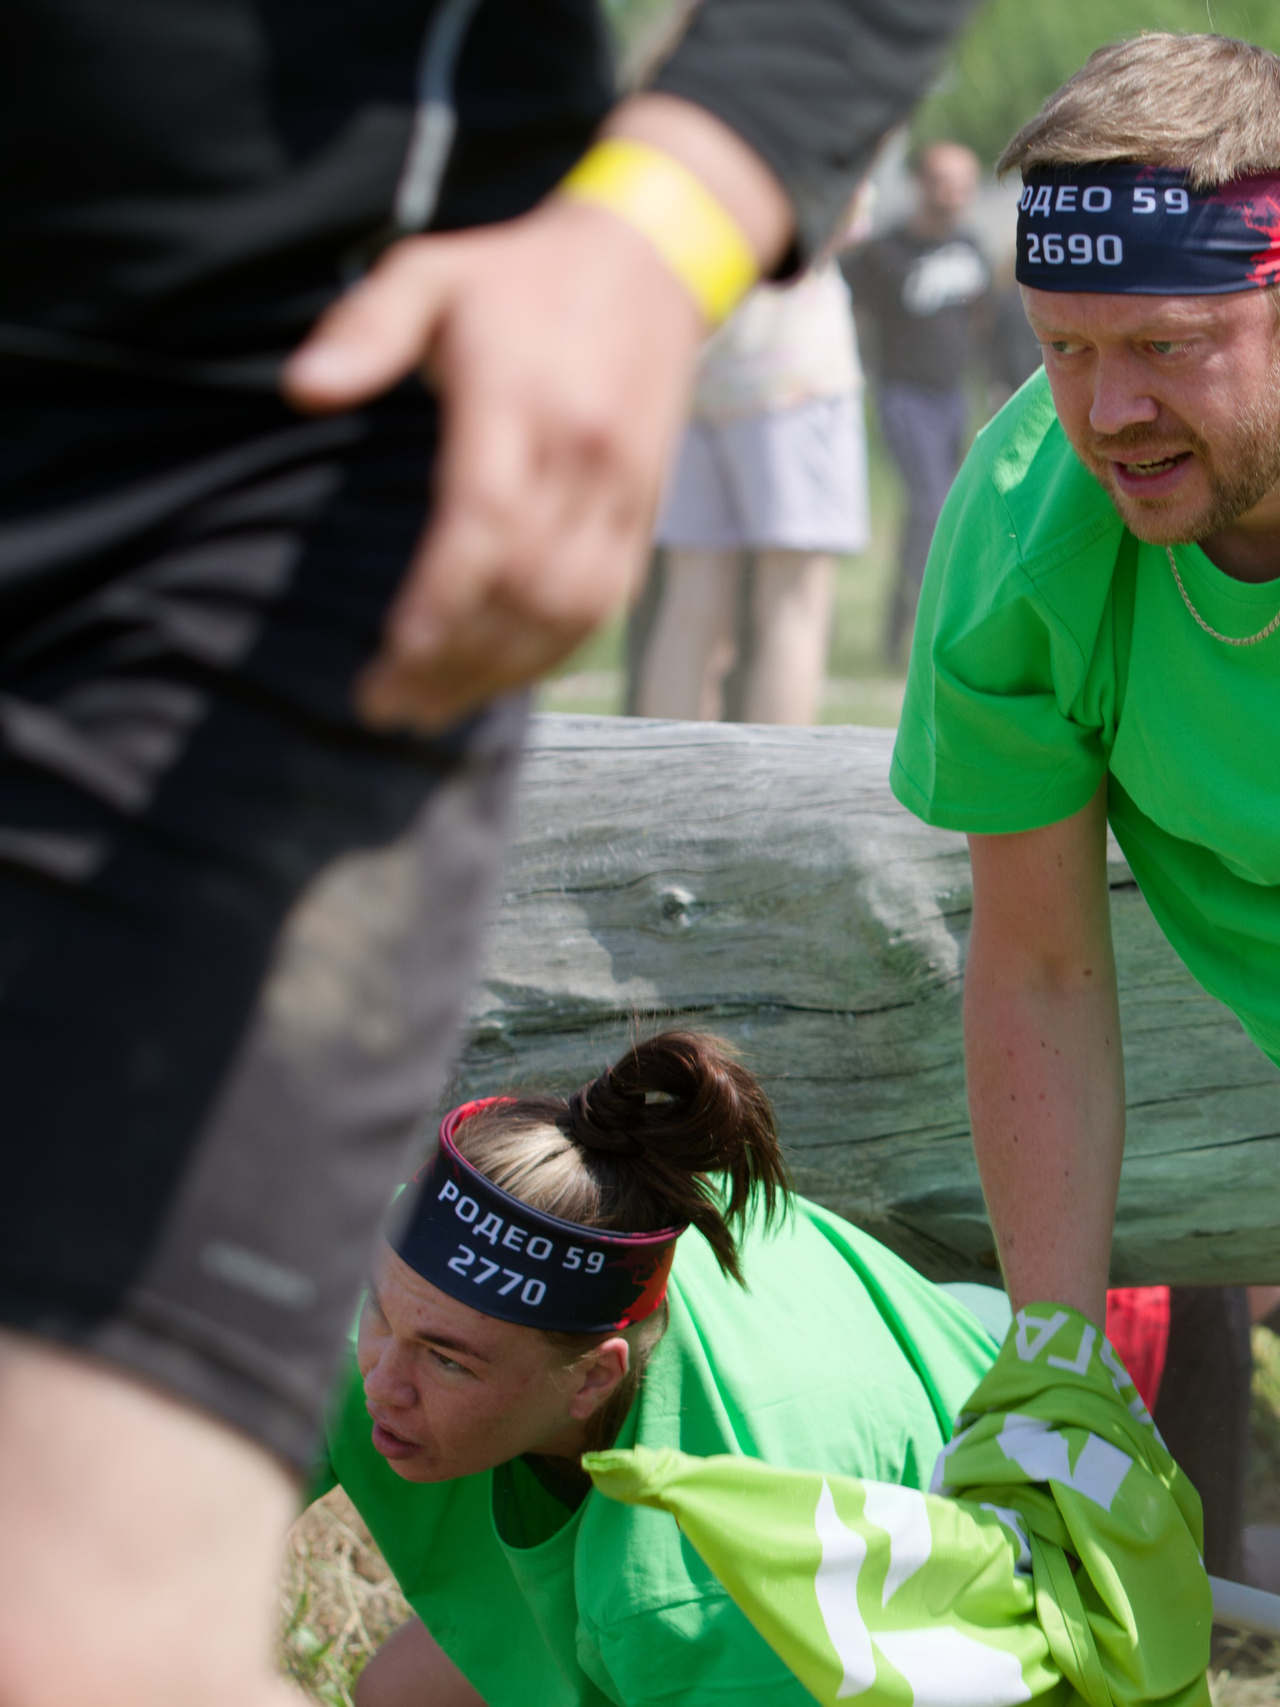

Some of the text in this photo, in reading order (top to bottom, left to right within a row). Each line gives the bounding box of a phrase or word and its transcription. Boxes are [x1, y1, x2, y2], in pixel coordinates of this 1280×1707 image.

[1017, 185, 1189, 218] ОДЕО 59
[1026, 232, 1123, 266] 2690
[437, 1180, 605, 1275] РОДЕО 59
[447, 1244, 547, 1306] 2770
